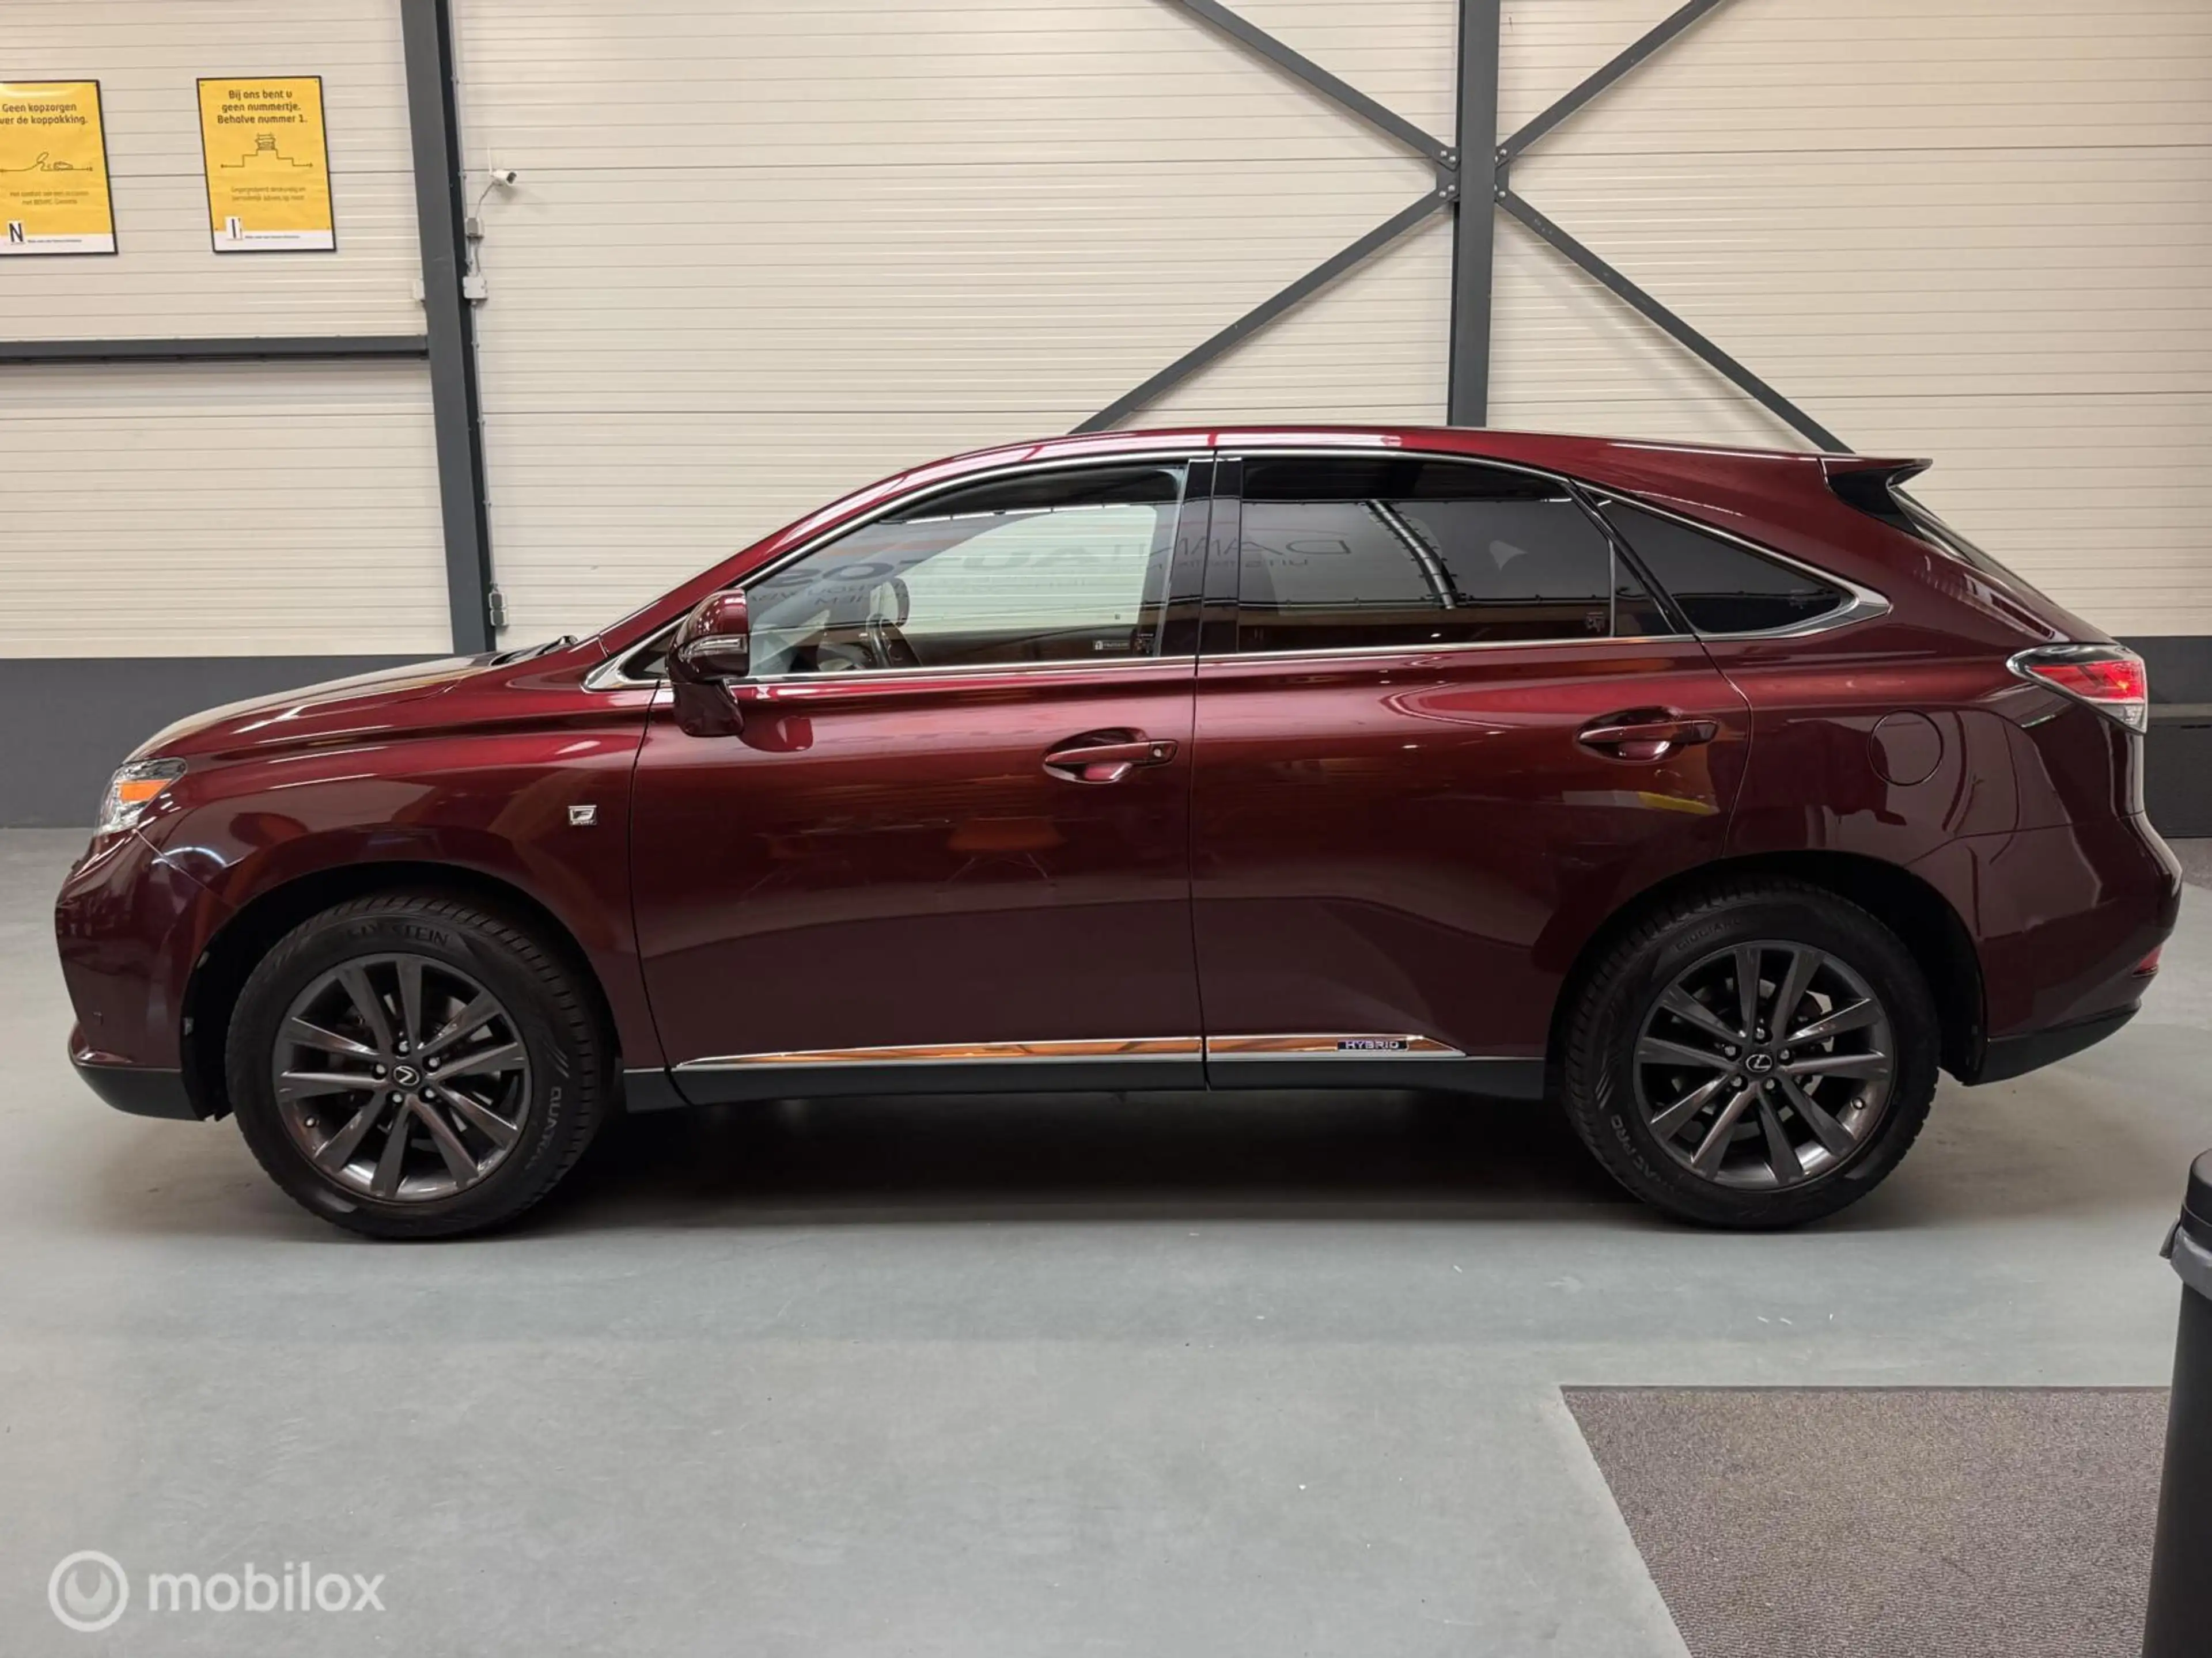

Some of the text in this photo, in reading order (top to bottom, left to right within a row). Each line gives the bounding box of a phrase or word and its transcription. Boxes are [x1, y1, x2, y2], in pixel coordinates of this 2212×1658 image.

[228, 90, 241, 101] Bij
[262, 89, 283, 98] bent
[286, 90, 293, 98] u
[2, 103, 77, 113] Geen kopzorgen
[221, 102, 301, 113] geen nummertje.
[16, 116, 28, 124] de
[31, 115, 88, 125] koppakking.
[217, 115, 255, 124] Behalve
[1344, 1040, 1400, 1050] HYBRID
